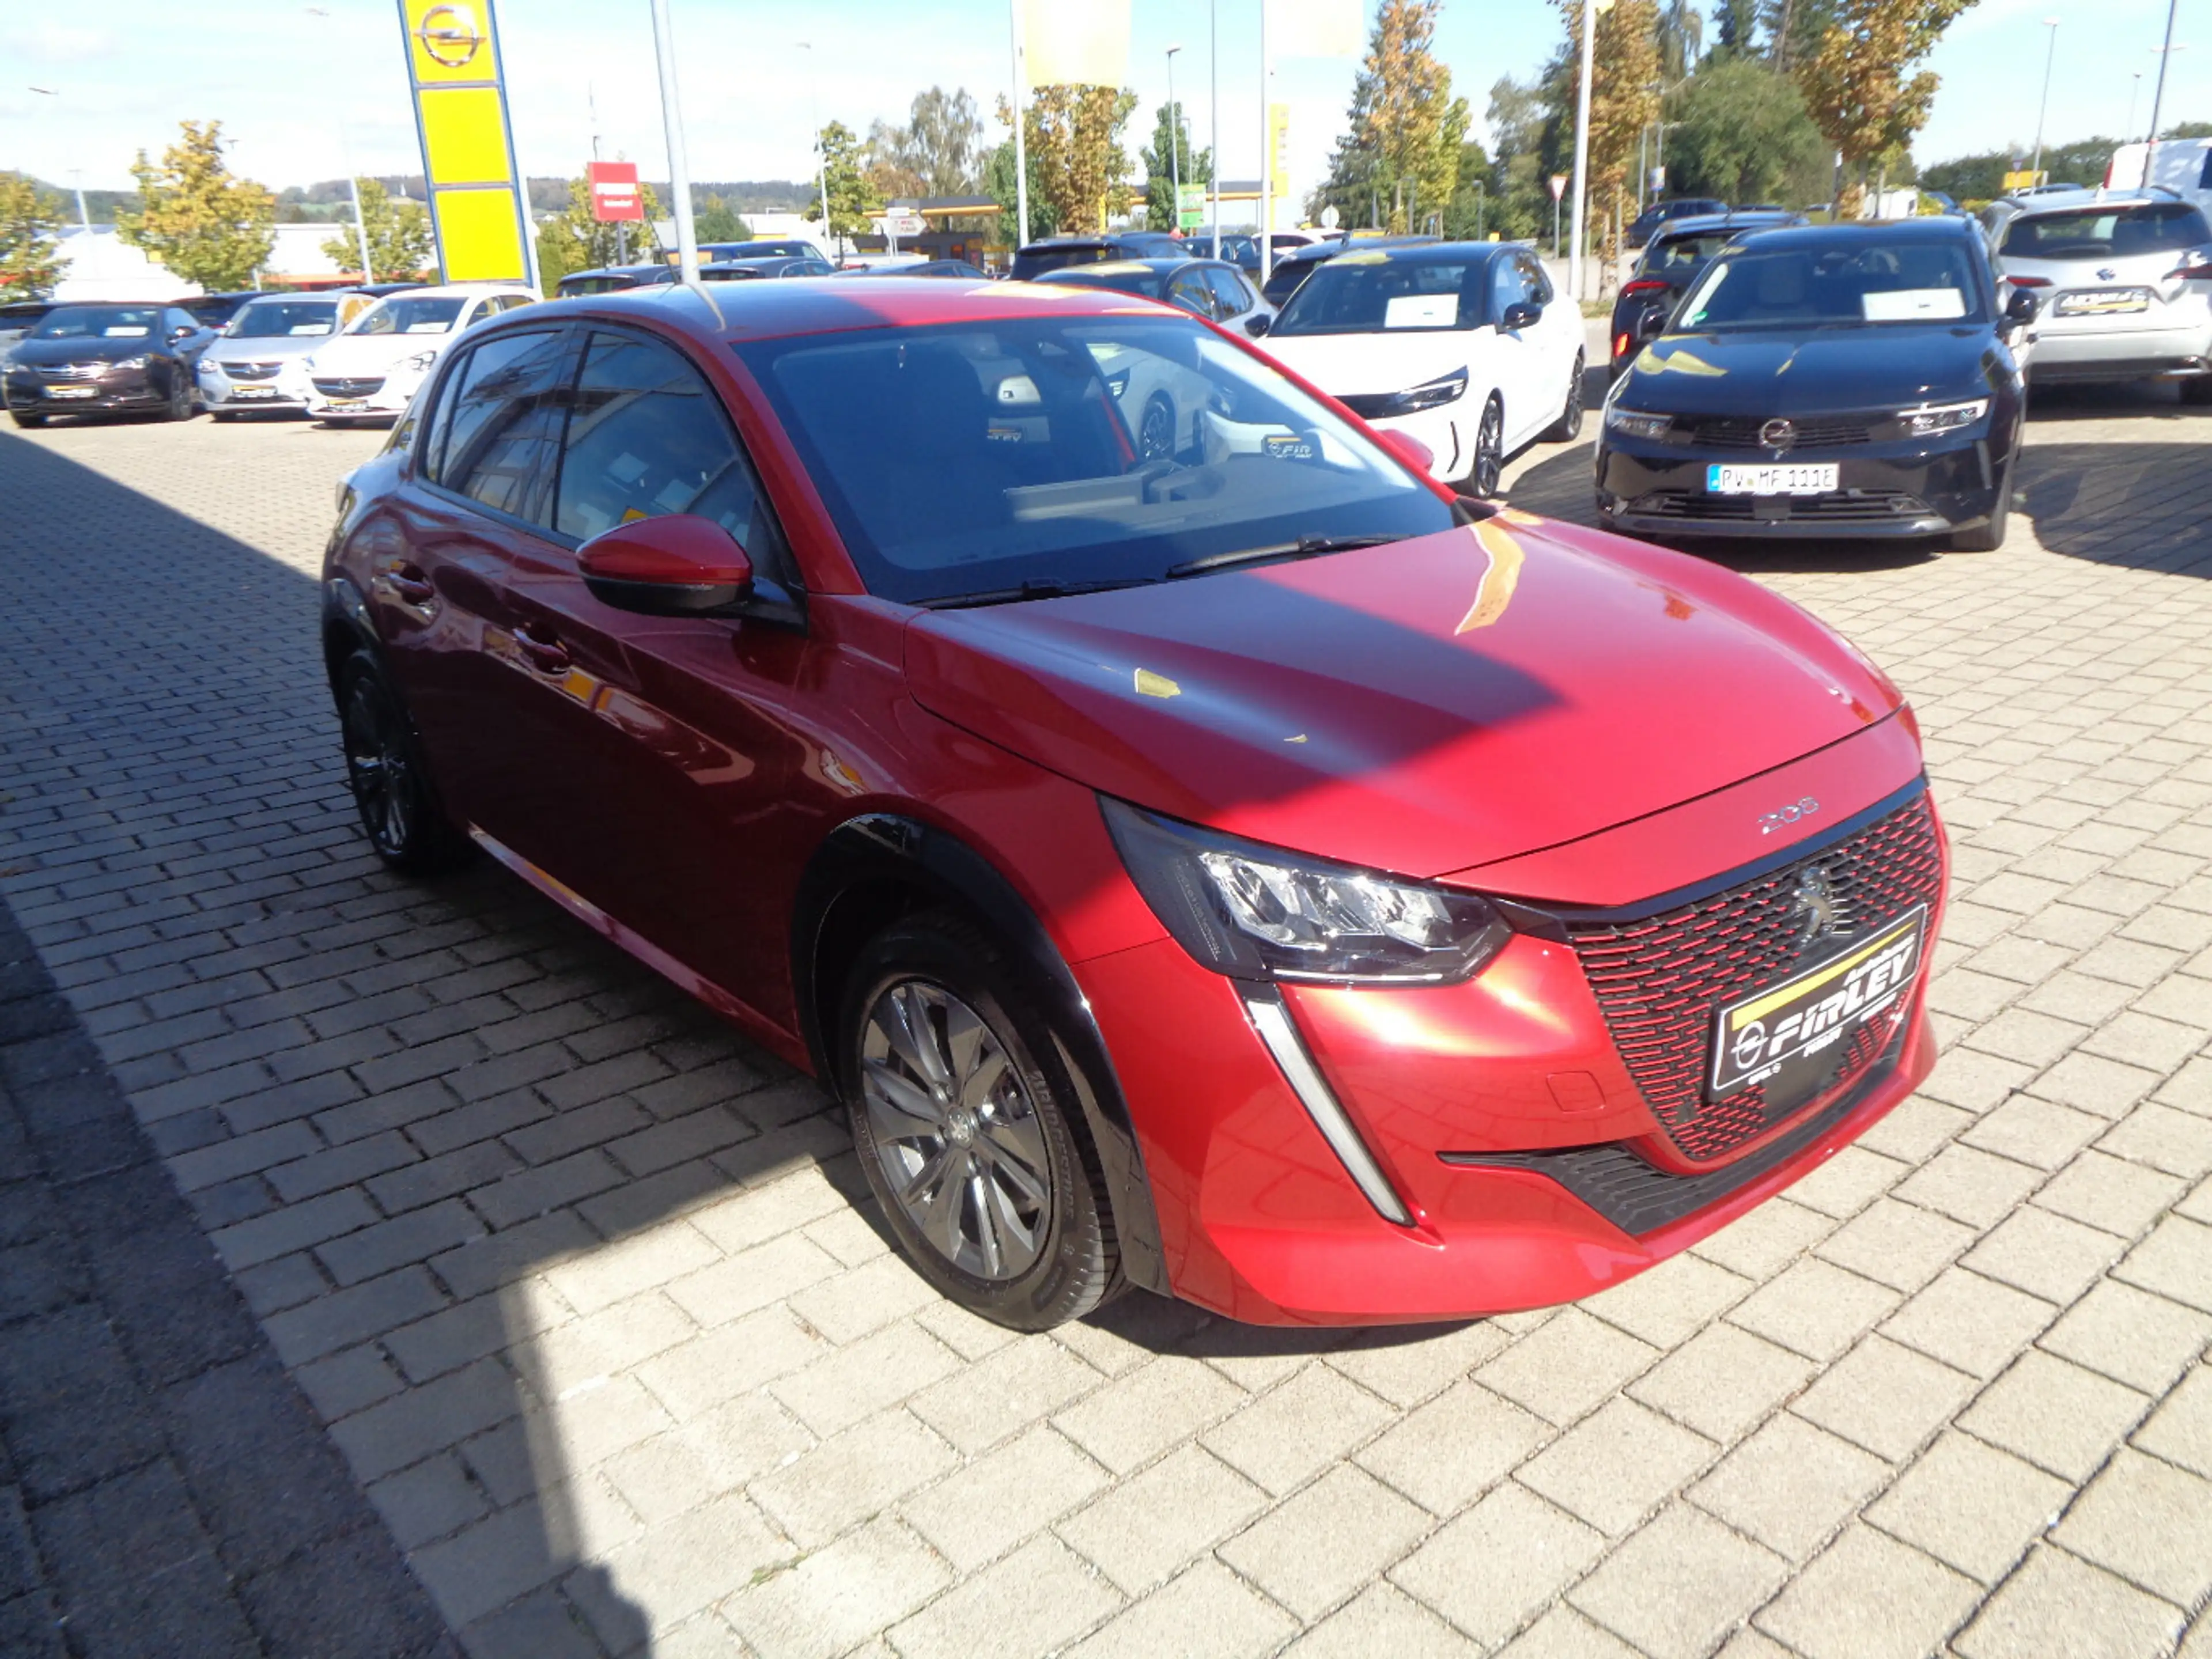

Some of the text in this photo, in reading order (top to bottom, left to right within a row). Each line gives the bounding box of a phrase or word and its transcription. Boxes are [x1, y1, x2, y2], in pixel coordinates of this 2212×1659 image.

[1756, 796, 1819, 835] 208
[1768, 944, 1915, 1056] FIRLEY
[1028, 1070, 1075, 1220] BRIDGESTONE
